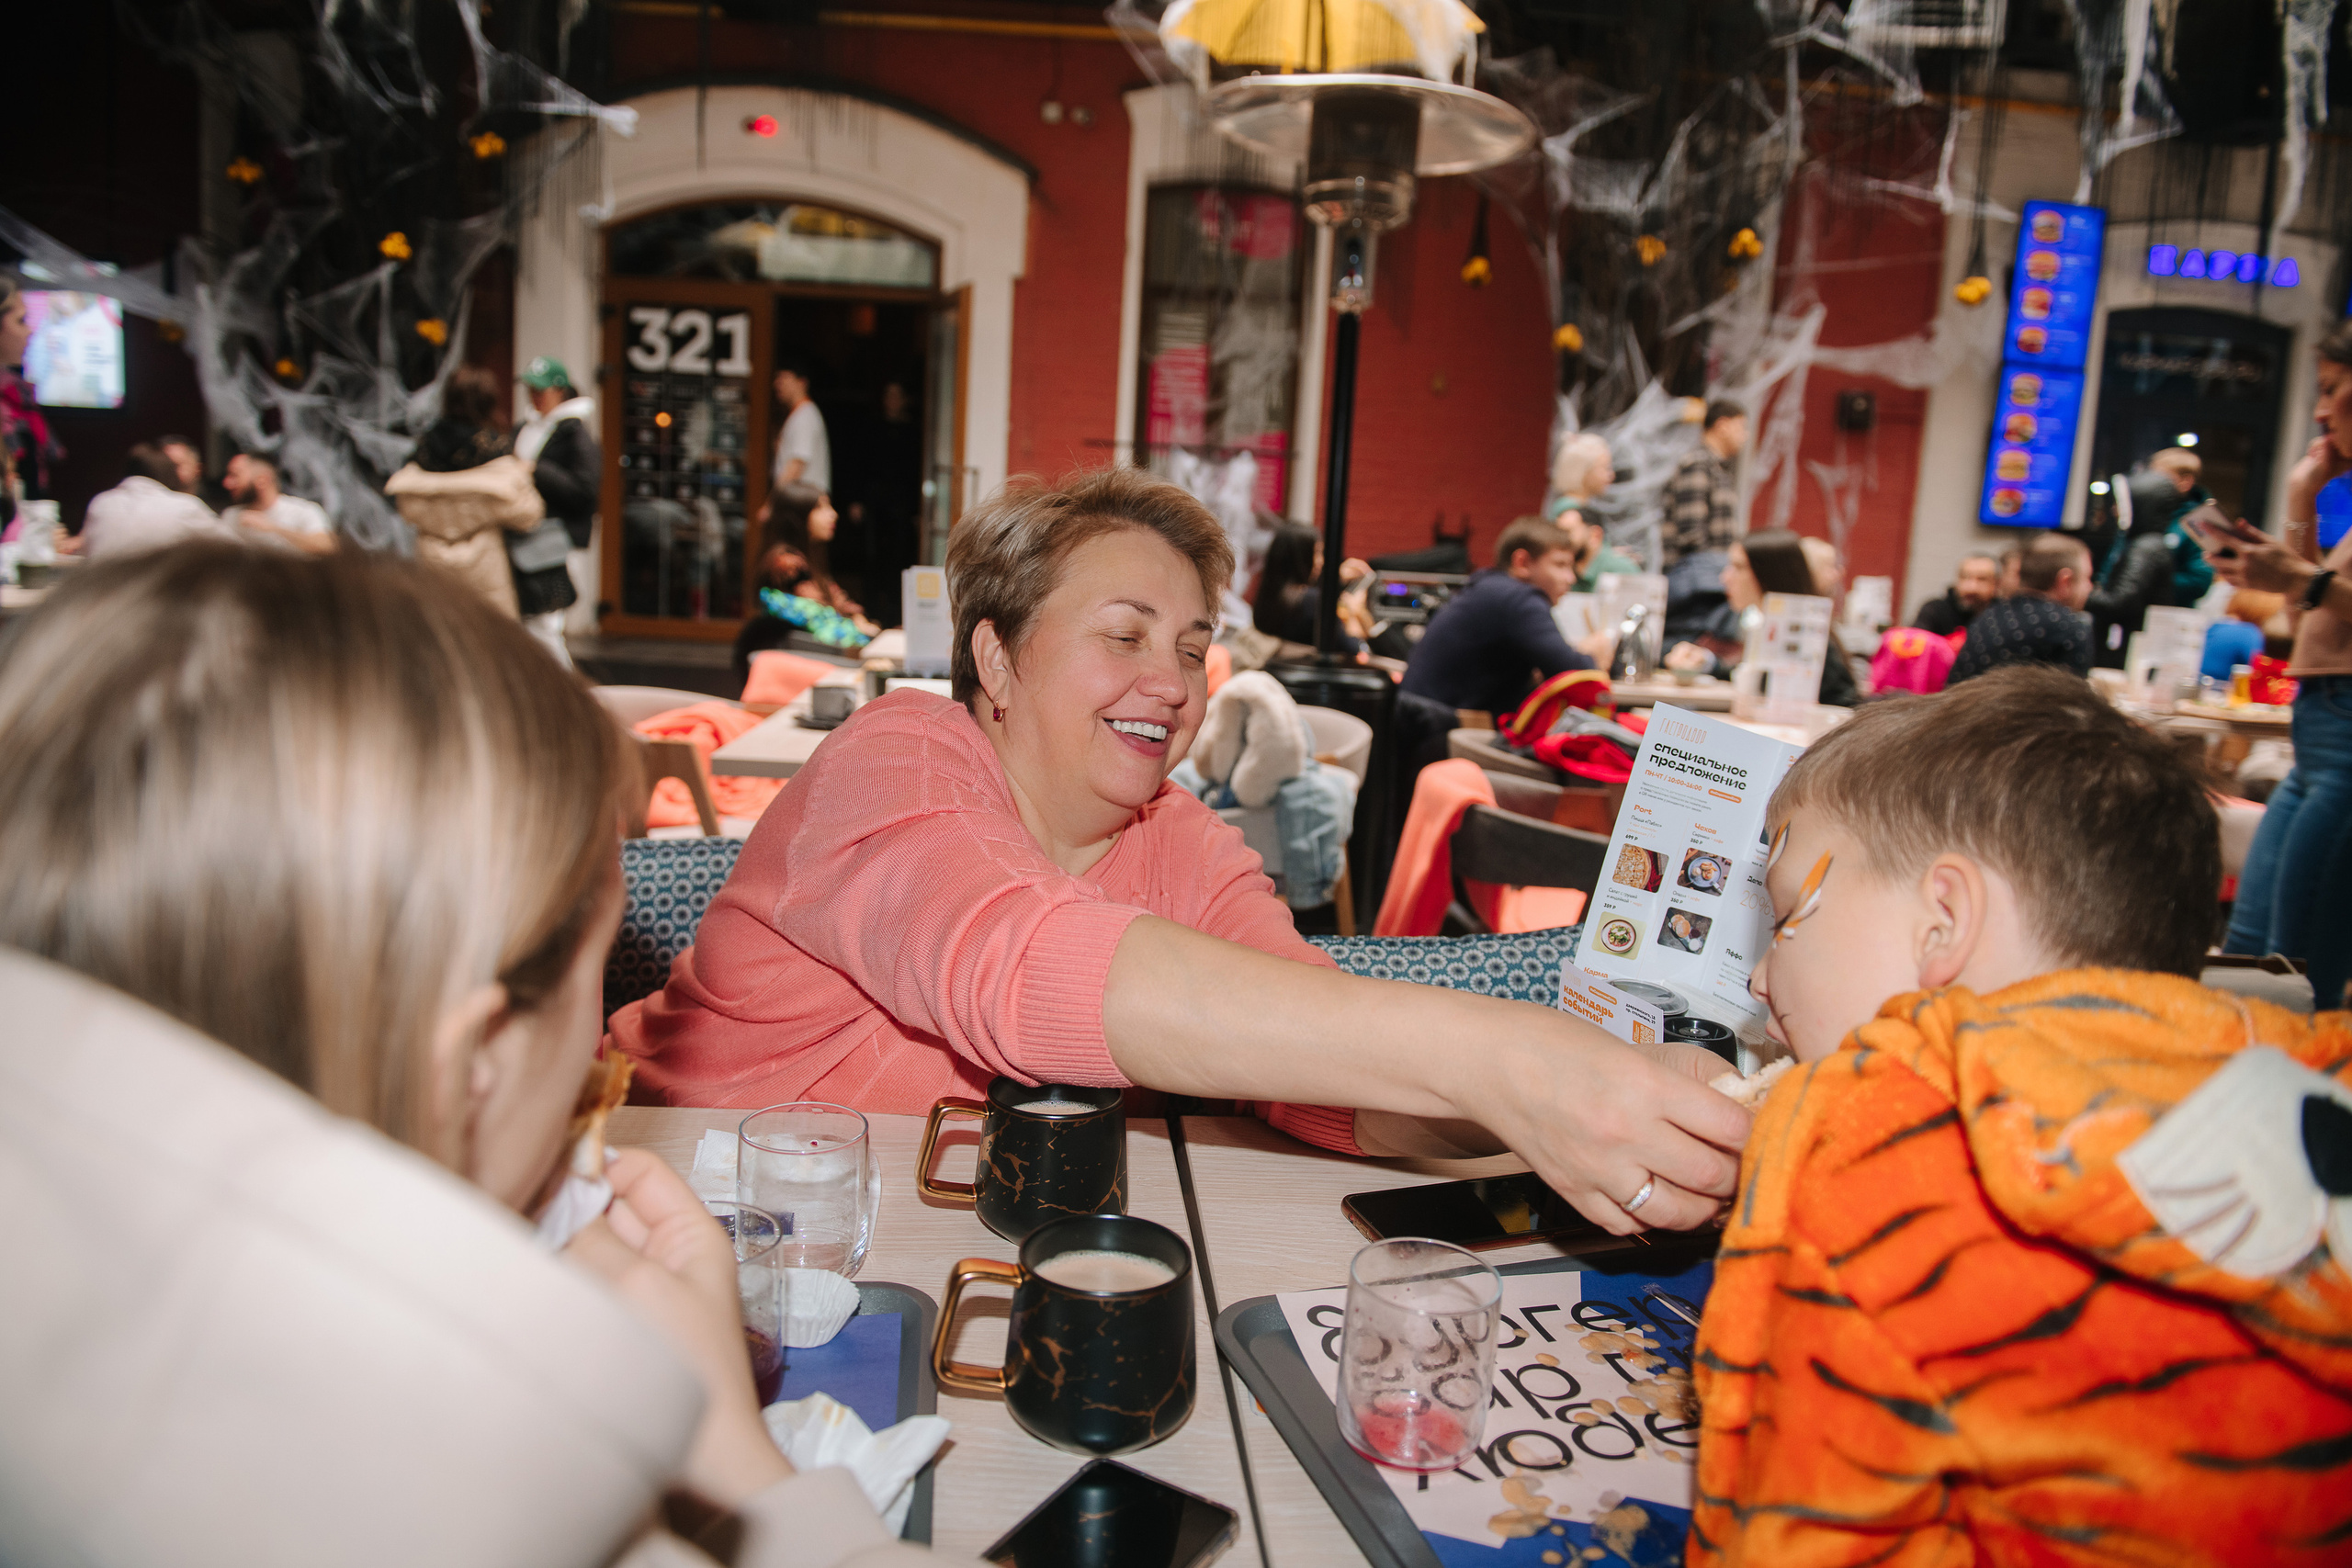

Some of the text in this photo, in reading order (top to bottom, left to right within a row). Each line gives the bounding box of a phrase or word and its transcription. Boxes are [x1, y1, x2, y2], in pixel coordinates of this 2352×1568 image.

[628, 306, 752, 378] 321
[1649, 753, 1747, 790] предложение
[1654, 742, 1747, 778] специальное
[1645, 769, 1664, 780] ПН-ЧТ
[1634, 804, 1653, 815] Port
[1694, 823, 1717, 834] Чехов
[1740, 889, 1771, 916] 20%
[1583, 966, 1608, 979] Карма
[1563, 996, 1603, 1025] событий
[1564, 985, 1614, 1019] календарь
